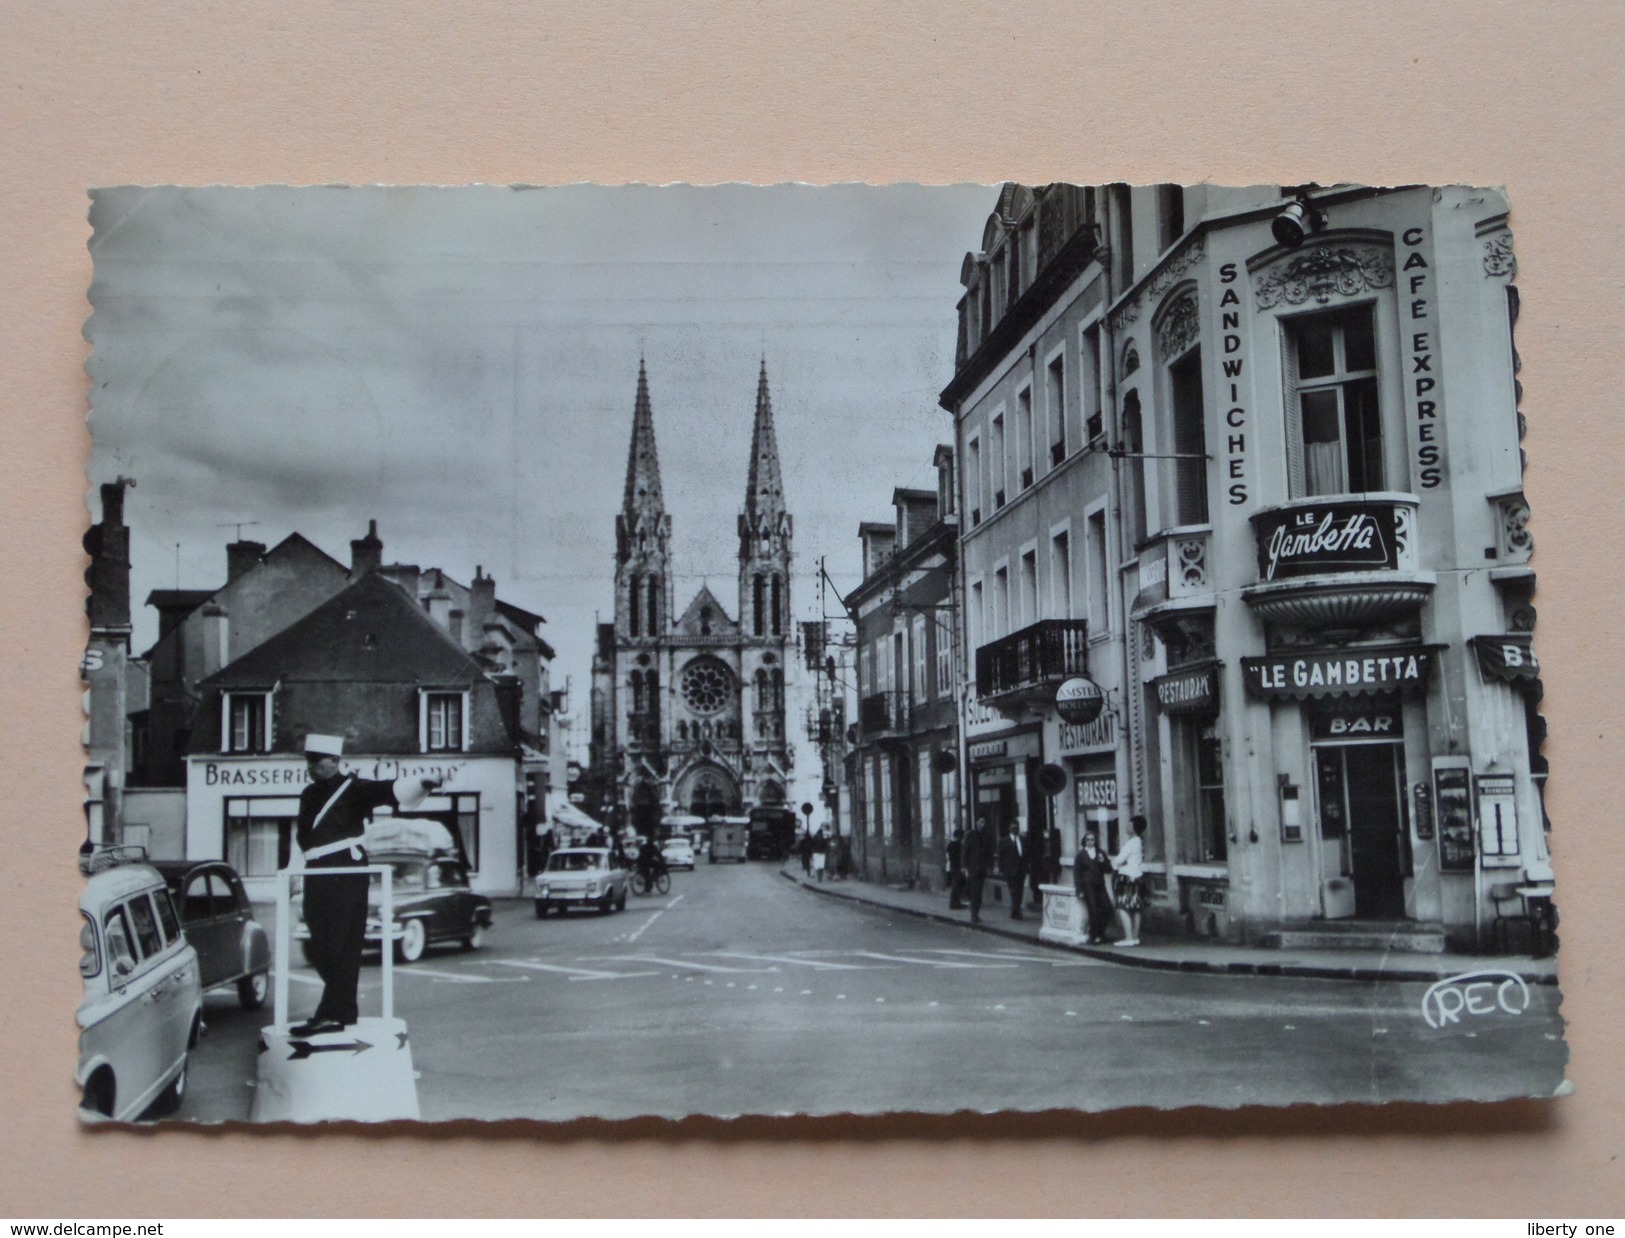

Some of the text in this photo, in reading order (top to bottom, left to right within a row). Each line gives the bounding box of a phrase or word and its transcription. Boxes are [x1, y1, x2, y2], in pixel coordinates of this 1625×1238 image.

[1219, 263, 1248, 506] SANDWICHES
[1412, 332, 1442, 489] EXPRESS
[1296, 513, 1314, 526] LE
[1158, 674, 1210, 704] RESTAURAN
[1059, 714, 1115, 750] RESTAURANT
[1330, 716, 1393, 734] BAR
